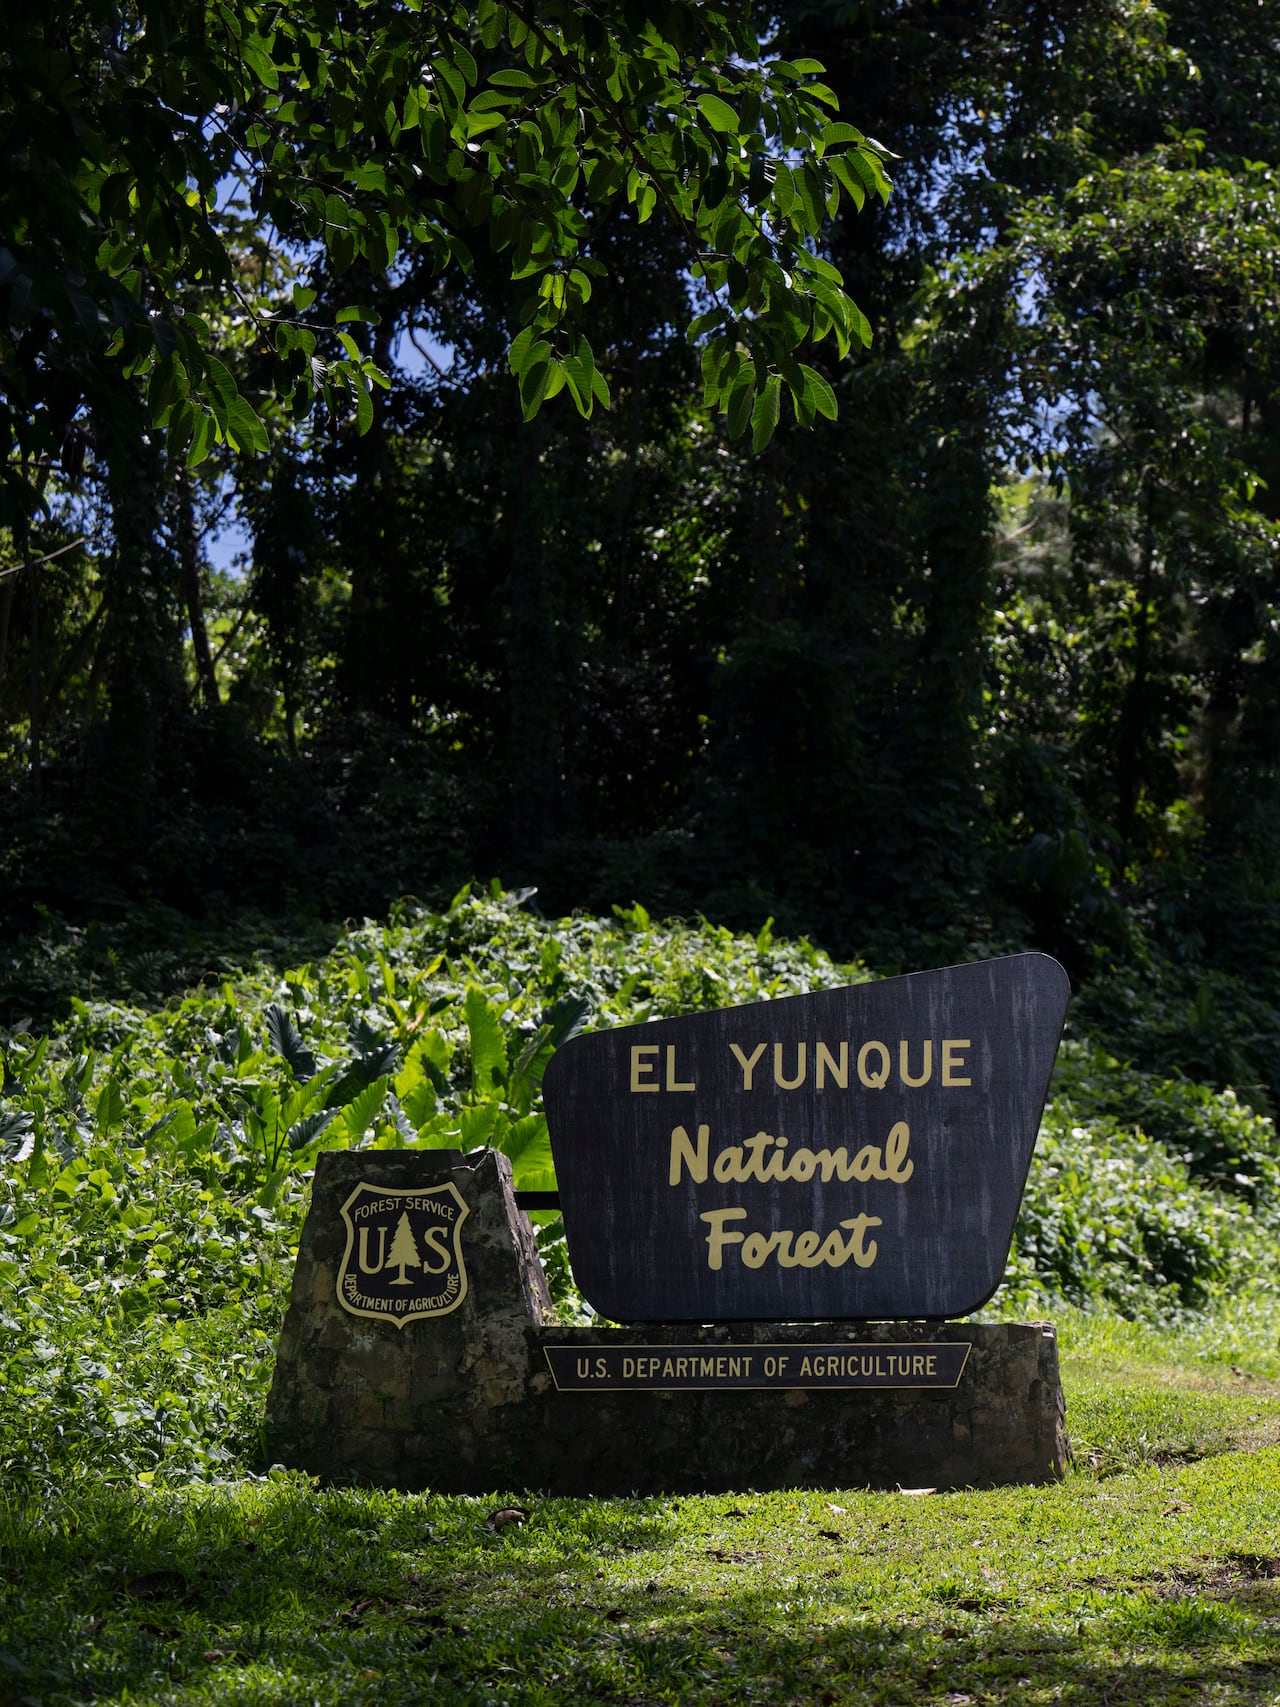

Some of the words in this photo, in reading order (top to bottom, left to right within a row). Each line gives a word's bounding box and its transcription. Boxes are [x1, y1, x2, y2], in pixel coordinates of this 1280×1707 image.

[630, 1045, 695, 1093] EL
[729, 1039, 972, 1091] YUNQUE
[669, 1121, 914, 1186] National
[355, 1198, 401, 1222] FOREST
[405, 1197, 454, 1222] SERVICE
[700, 1207, 883, 1271] Forest
[345, 1273, 394, 1311] DEPARTMENT
[395, 1299, 408, 1311] OF
[408, 1273, 459, 1311] AGRICULTURE
[577, 1358, 611, 1378] U.S.
[623, 1357, 753, 1378] DEPARTMENT
[764, 1356, 789, 1377] OF
[800, 1355, 938, 1377] AGRICULTURE
